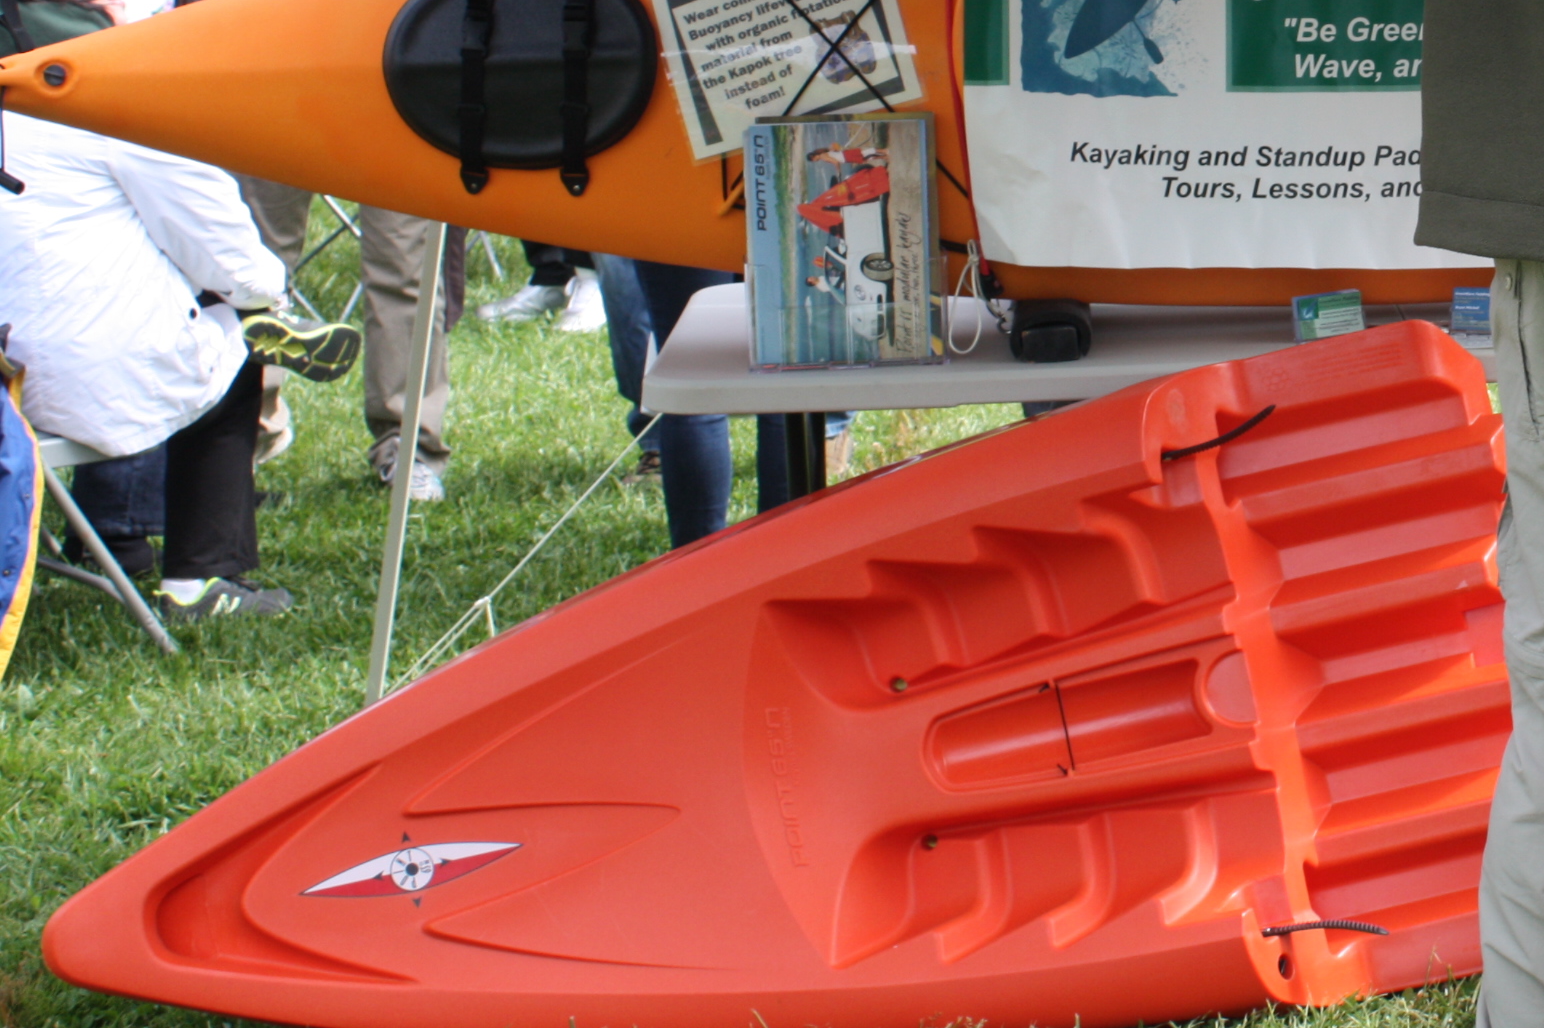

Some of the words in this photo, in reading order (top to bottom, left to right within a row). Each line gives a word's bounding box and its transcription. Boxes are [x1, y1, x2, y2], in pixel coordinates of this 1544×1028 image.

[683, 6, 719, 25] Wear
[687, 9, 753, 41] Buoyancy
[705, 34, 735, 52] with
[738, 15, 789, 38] organic
[700, 41, 757, 72] material
[759, 29, 793, 50] from
[702, 72, 726, 89] the
[728, 55, 773, 81] Kapok
[773, 44, 803, 62] tree
[724, 72, 776, 100] instead
[779, 63, 793, 79] of
[1294, 54, 1382, 82] Wave,
[745, 86, 786, 110] foam!
[1070, 142, 1190, 171] Kayaking
[1198, 145, 1247, 167] and
[1255, 145, 1365, 172] Standup
[756, 179, 767, 231] POINT
[1161, 177, 1243, 202] Tours,
[1252, 177, 1371, 203] Lessons,
